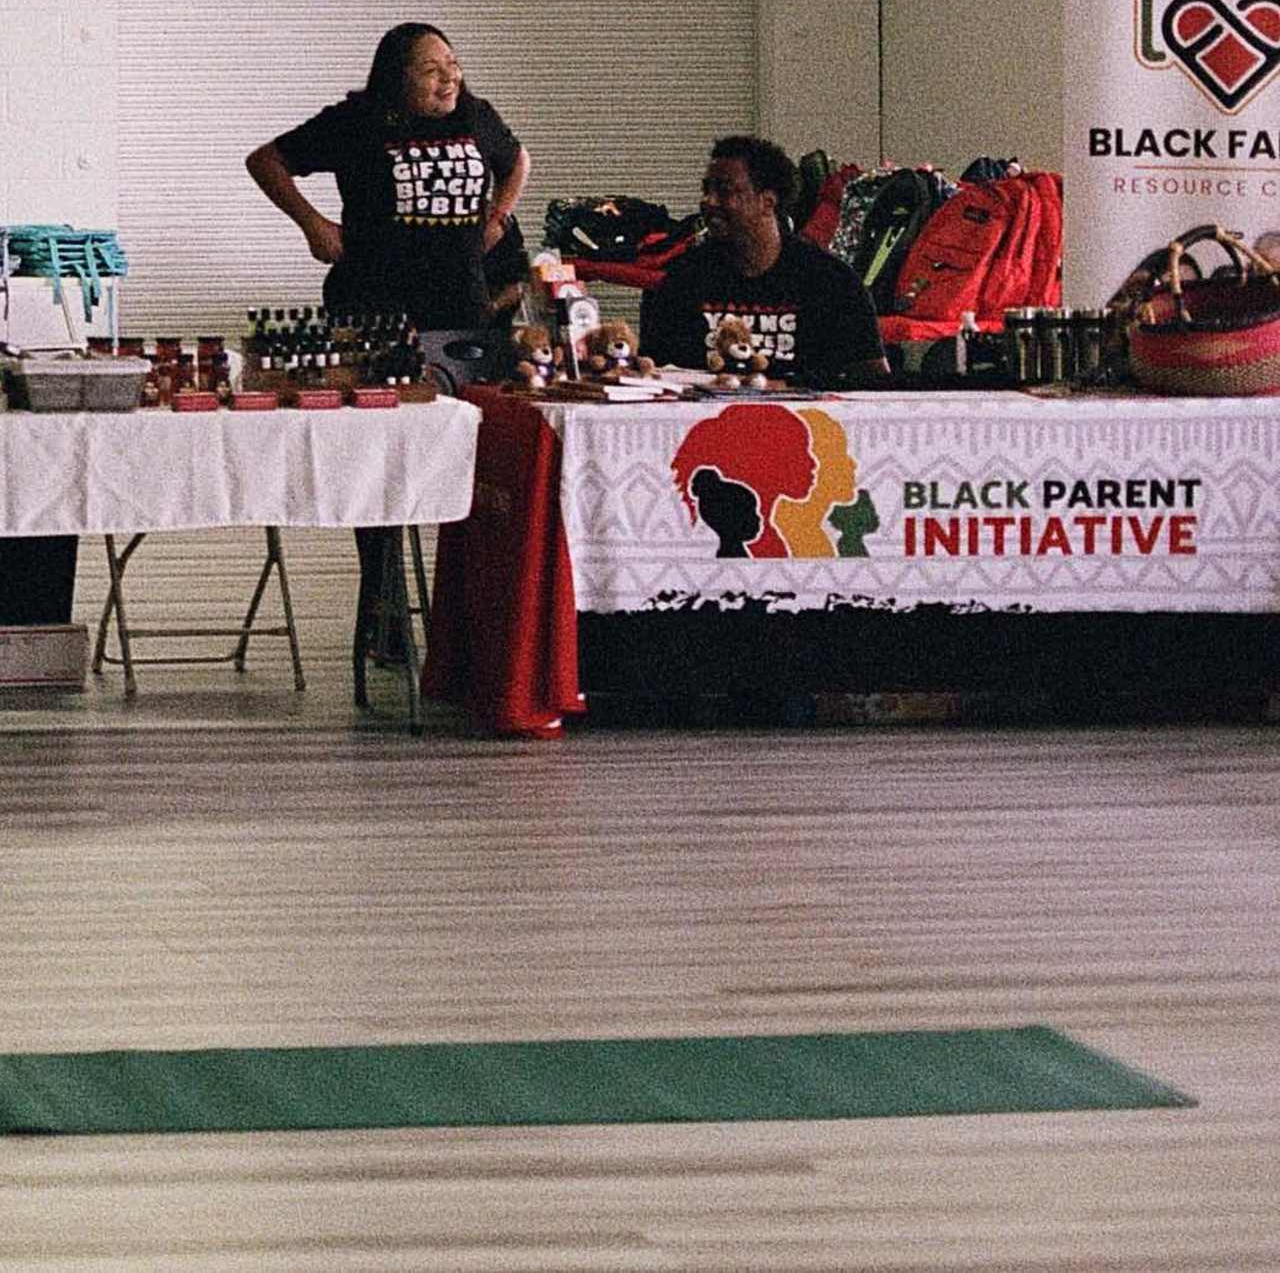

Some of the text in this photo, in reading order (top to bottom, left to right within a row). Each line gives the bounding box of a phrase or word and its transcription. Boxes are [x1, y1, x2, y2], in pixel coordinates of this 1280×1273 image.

[387, 143, 482, 163] YOUNG
[1089, 128, 1280, 159] BLACK FA
[392, 160, 485, 181] GIFTED
[396, 178, 484, 199] BLACK
[1114, 177, 1246, 197] RESOURCE
[396, 196, 480, 216] NOBLE
[903, 478, 1203, 510] BLACK PARENT
[904, 514, 1199, 557] INITIATIVE
